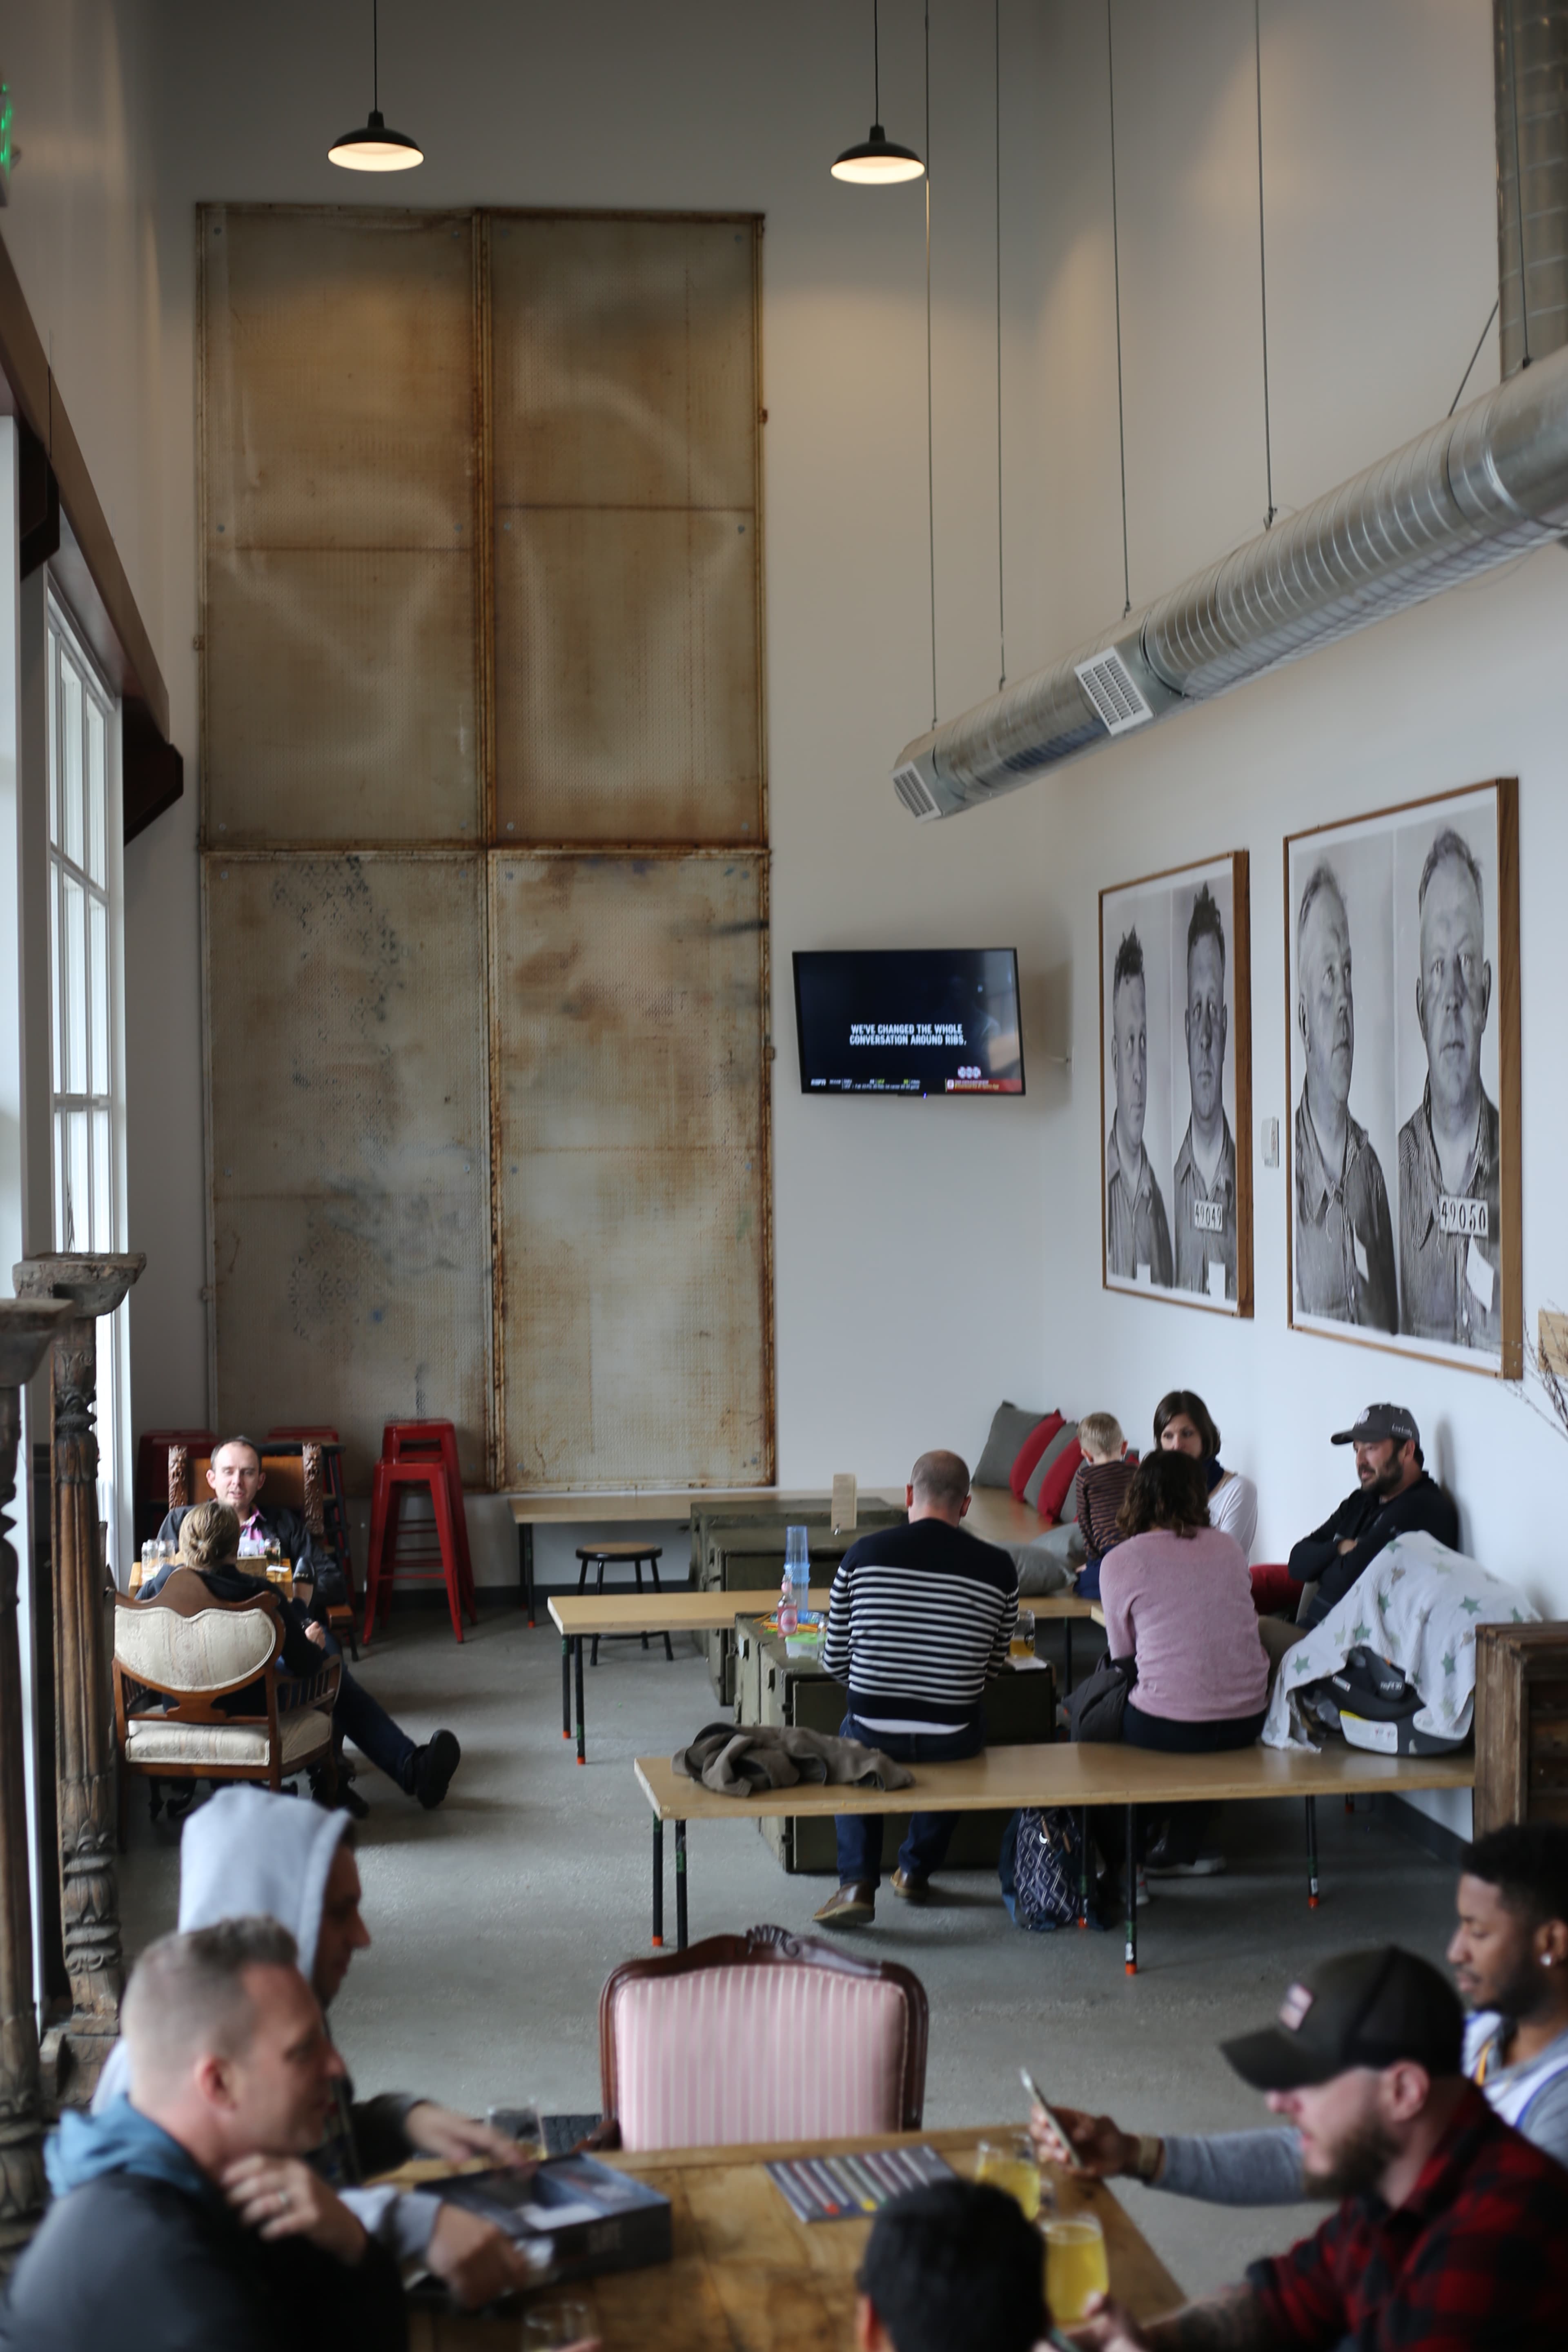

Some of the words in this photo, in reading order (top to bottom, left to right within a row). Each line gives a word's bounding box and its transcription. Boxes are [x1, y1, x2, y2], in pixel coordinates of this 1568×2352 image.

[851, 1024, 875, 1034] WE'VE
[878, 1024, 914, 1034] CHANGED
[916, 1024, 932, 1034] THE
[933, 1024, 962, 1034] WHOLE
[849, 1035, 908, 1046] CONVERSATION
[910, 1035, 943, 1046] AROUND
[1195, 1203, 1221, 1229] 49049
[1441, 1200, 1486, 1232] 49050
